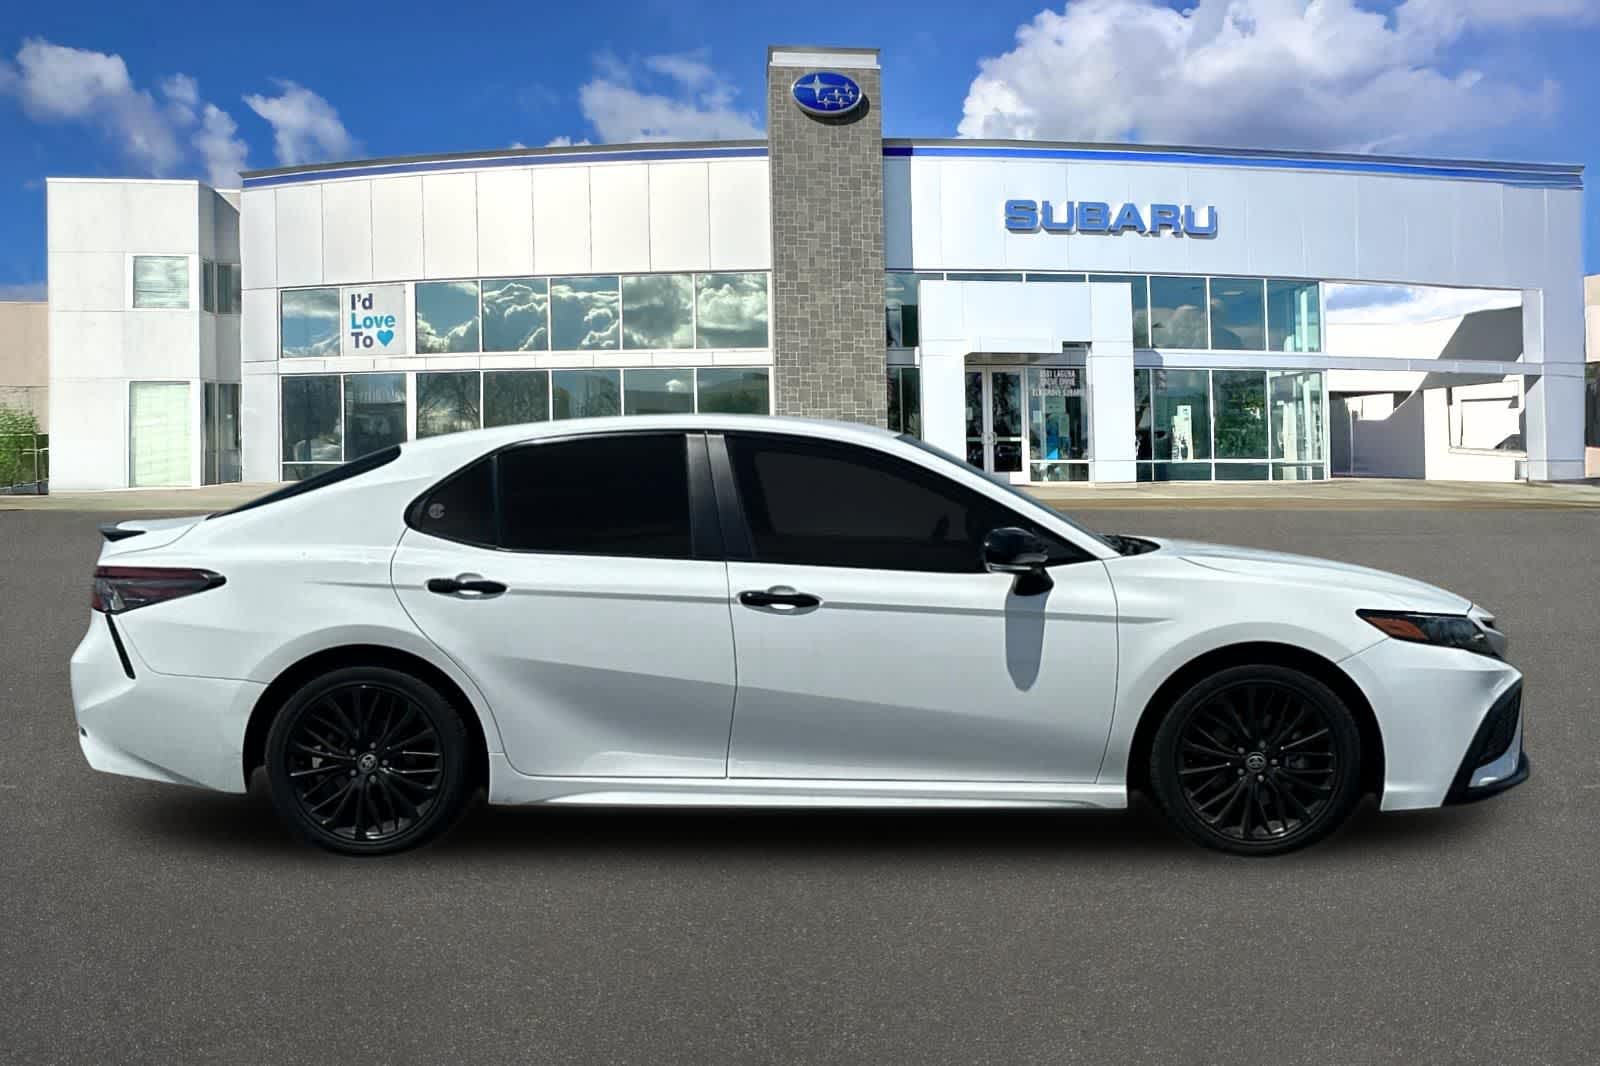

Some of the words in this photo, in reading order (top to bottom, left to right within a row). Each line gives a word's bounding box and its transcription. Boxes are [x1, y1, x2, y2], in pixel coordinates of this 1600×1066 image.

[1005, 199, 1217, 238] SUBARU
[351, 293, 373, 310] I'd
[351, 312, 396, 329] Love
[351, 331, 374, 348] To
